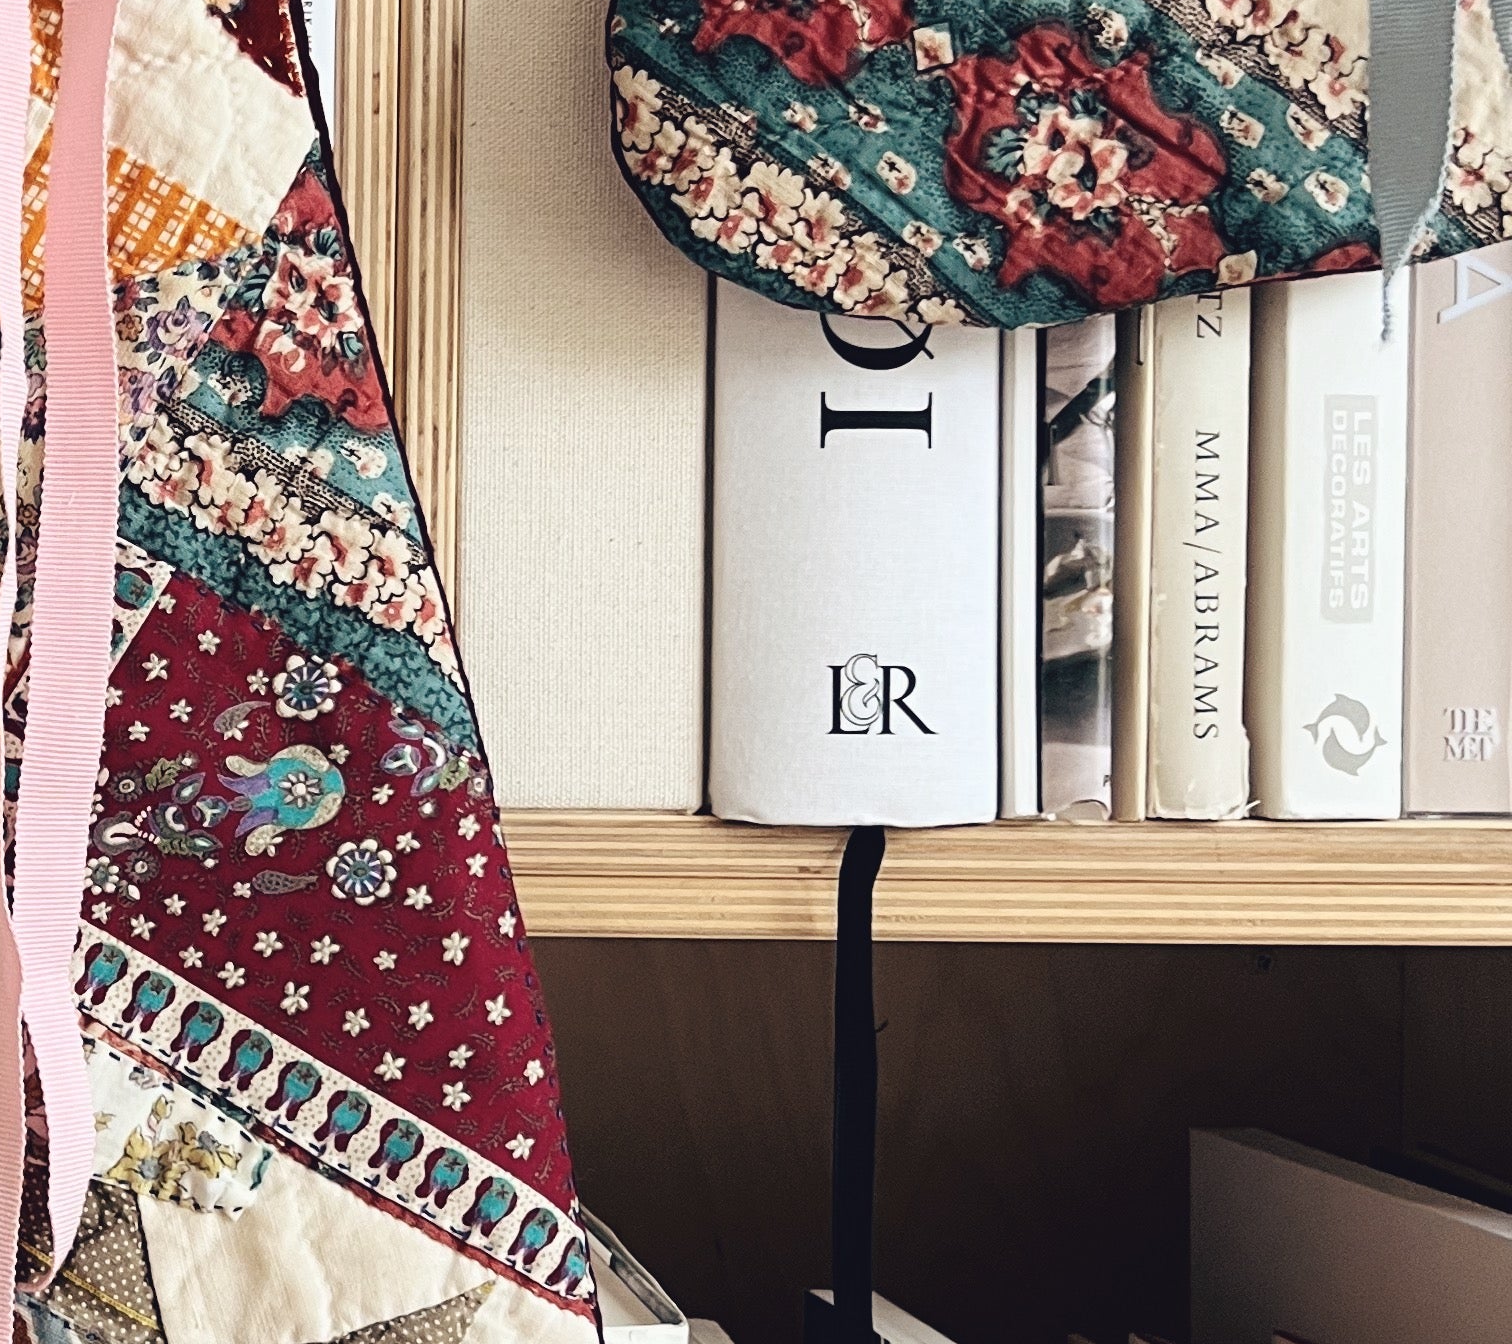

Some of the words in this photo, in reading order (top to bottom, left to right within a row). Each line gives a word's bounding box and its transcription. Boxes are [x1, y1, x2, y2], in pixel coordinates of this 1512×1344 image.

[1328, 411, 1347, 609] DECORATIFS
[1351, 412, 1372, 486] LES
[1183, 431, 1221, 741] MMA/ABRAMS
[1350, 500, 1372, 611] ARTS
